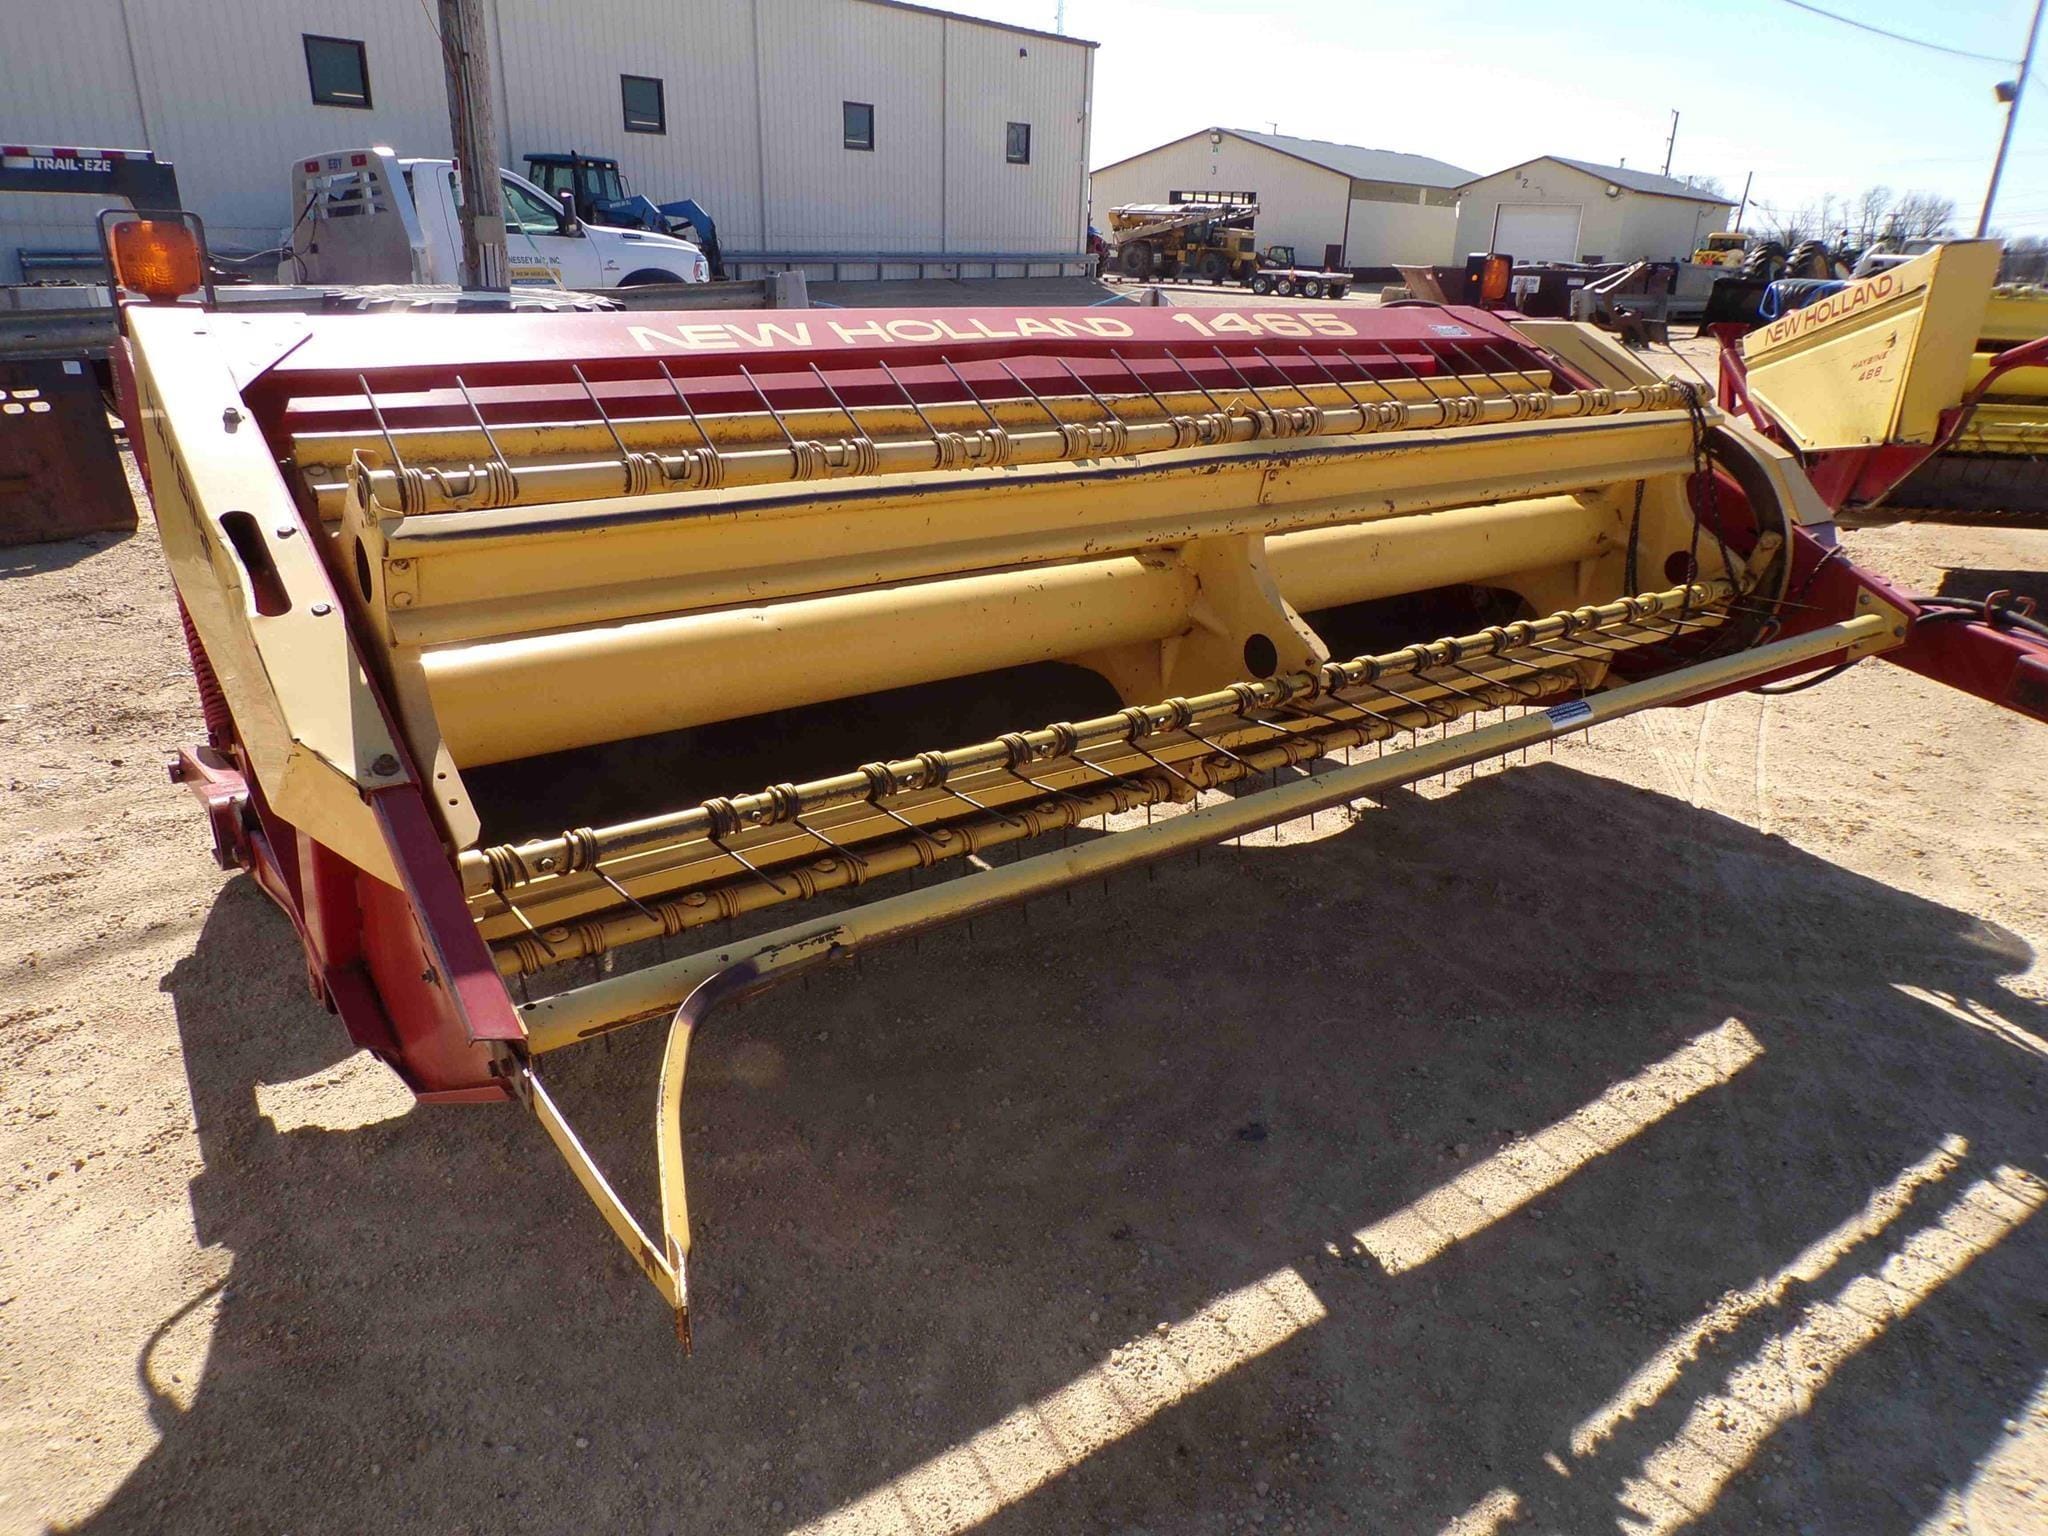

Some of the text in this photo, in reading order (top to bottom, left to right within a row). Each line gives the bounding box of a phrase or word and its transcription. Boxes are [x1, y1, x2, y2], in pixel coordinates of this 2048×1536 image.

[34, 157, 111, 172] TRAIL-EZE
[1765, 274, 1893, 346] NEW HOLLAND
[627, 312, 1359, 352] NEW HOLLAND 1465
[1858, 366, 1883, 381] 488
